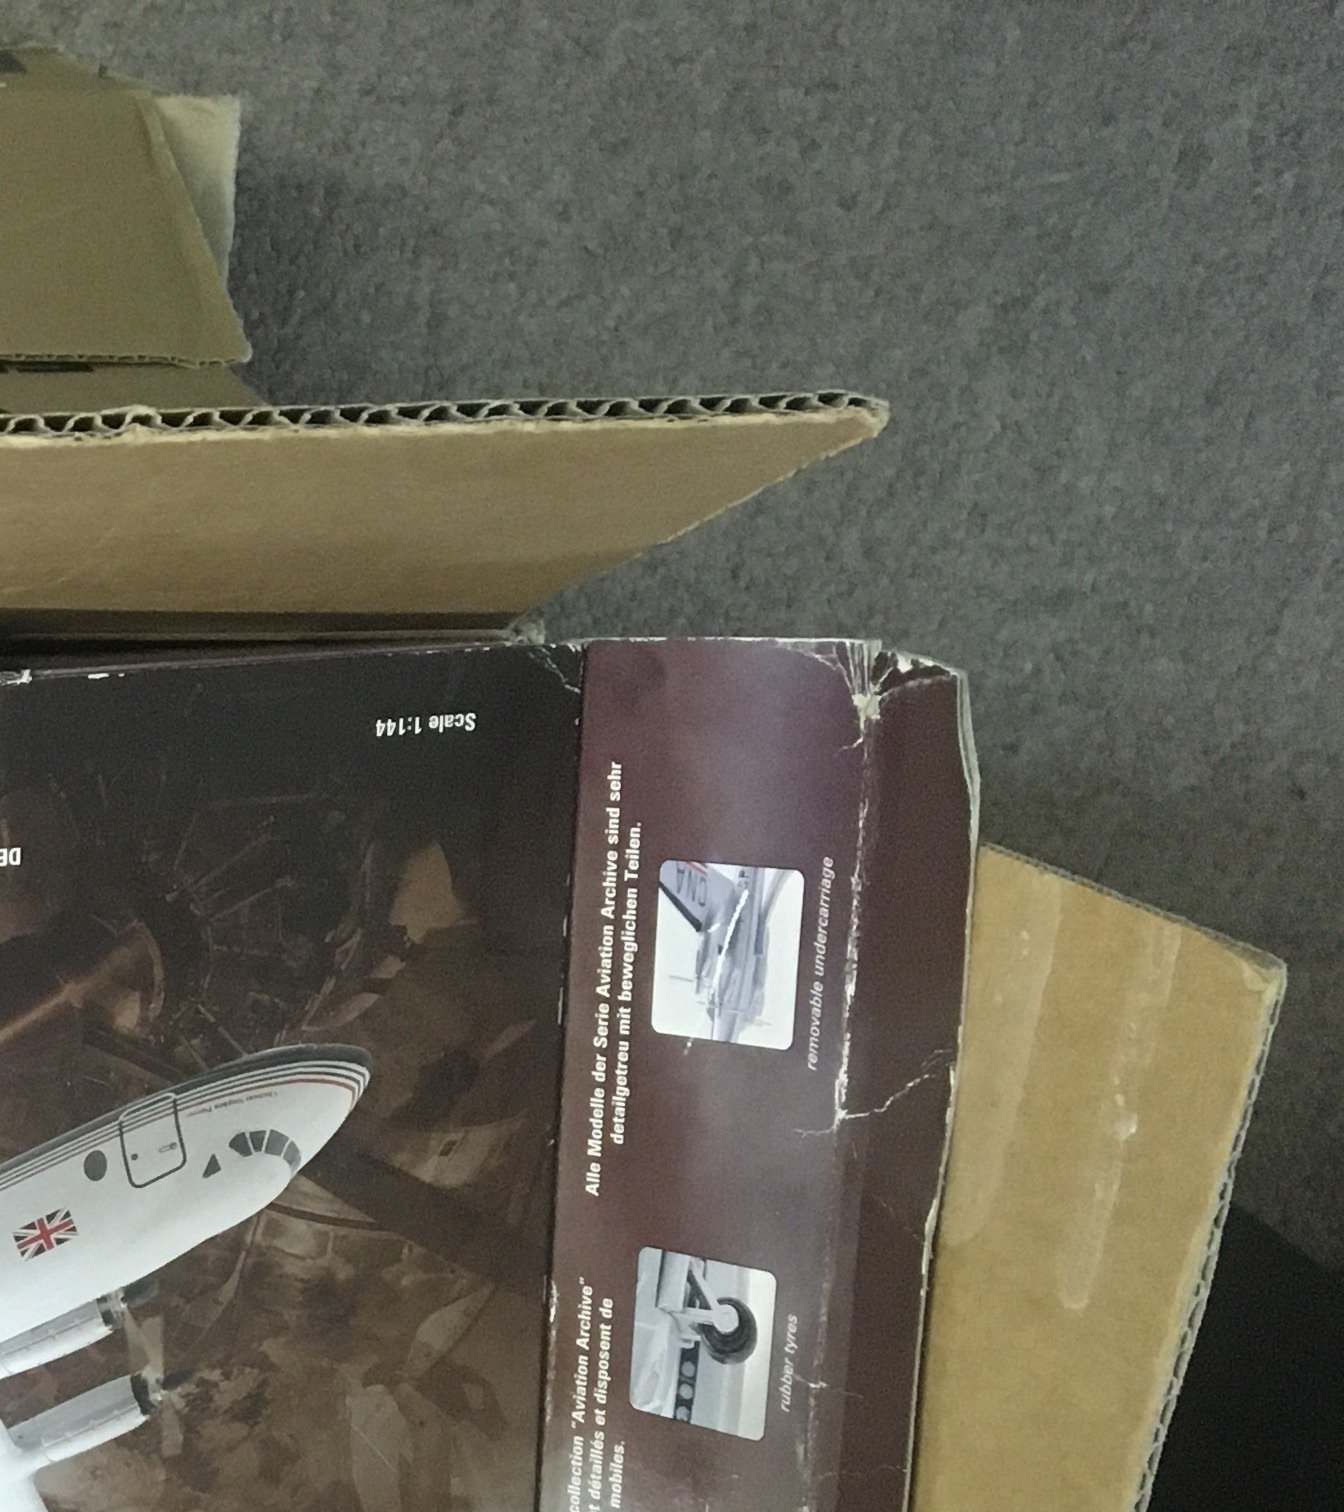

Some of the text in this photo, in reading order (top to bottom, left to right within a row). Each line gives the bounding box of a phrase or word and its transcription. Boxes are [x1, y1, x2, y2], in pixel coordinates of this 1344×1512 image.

[375, 711, 477, 737] Scale 1:144
[585, 761, 622, 1197] Alle Modelle der Serie Aviation Archive sind sehr
[610, 821, 643, 1145] detailgetreu mit beweglichen Teilen.
[807, 856, 836, 1071] removable undercarriage
[599, 1297, 614, 1319] de
[593, 1323, 613, 1405] disposent
[778, 1314, 799, 1413] rubber tyres
[594, 1409, 607, 1426] et
[588, 1430, 605, 1500] détaillés
[608, 1440, 626, 1509] mobiles.
